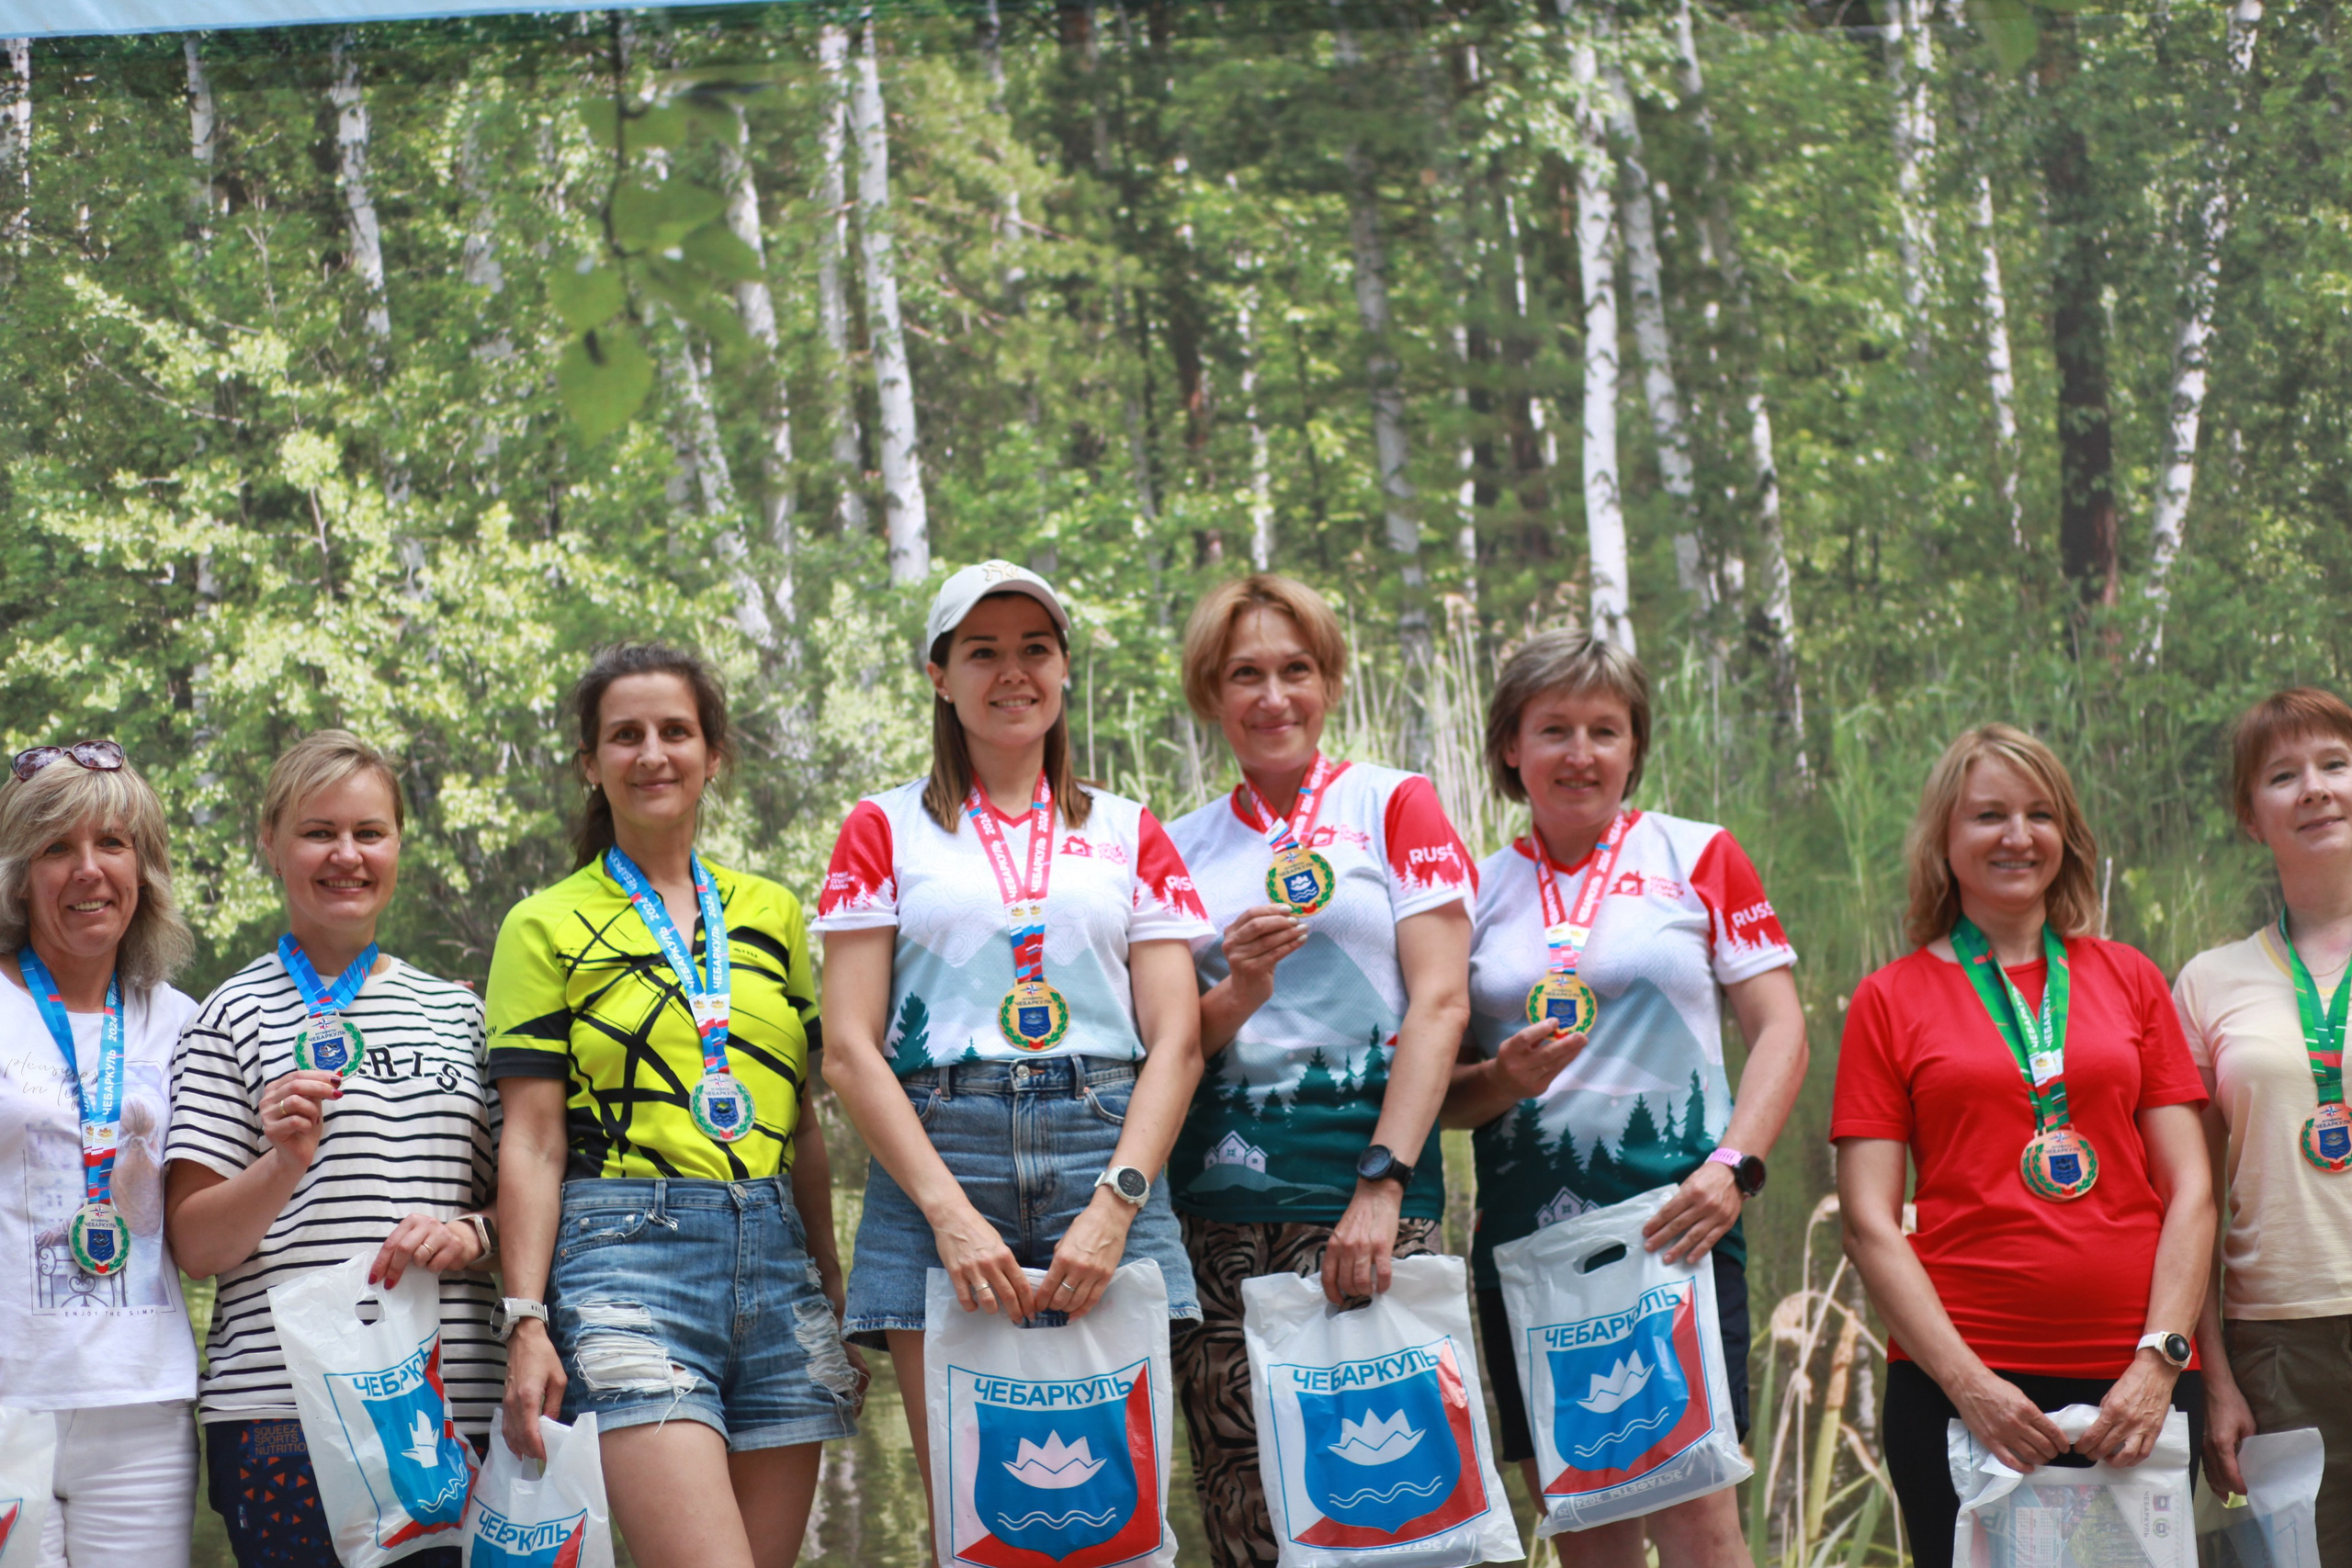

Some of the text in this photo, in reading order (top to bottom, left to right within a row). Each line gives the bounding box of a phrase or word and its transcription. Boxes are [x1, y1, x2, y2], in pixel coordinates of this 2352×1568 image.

[978, 812, 1018, 898] ЧЕБАРКУЛЬ 2024
[639, 897, 695, 989] ЧЕБАРКУЛЬ 2024
[706, 895, 723, 989] ЧЕБАРКУЛЬ 2024
[107, 1016, 119, 1043] 2024
[308, 1031, 346, 1042] ЧЕБАРКУЛЬ
[102, 1049, 118, 1116] ЧЕБАРКУЛЬ
[356, 1045, 464, 1093] RIS
[1293, 1349, 1441, 1392] ЧЕБАРКУЛЬ
[973, 1376, 1134, 1406] ЧЕБАРКУЛЬ
[254, 1433, 299, 1446] SPORTS
[254, 1442, 307, 1456] NUTRITIO
[1574, 1470, 1683, 1508] ЭСТАФЕТЫ 2024
